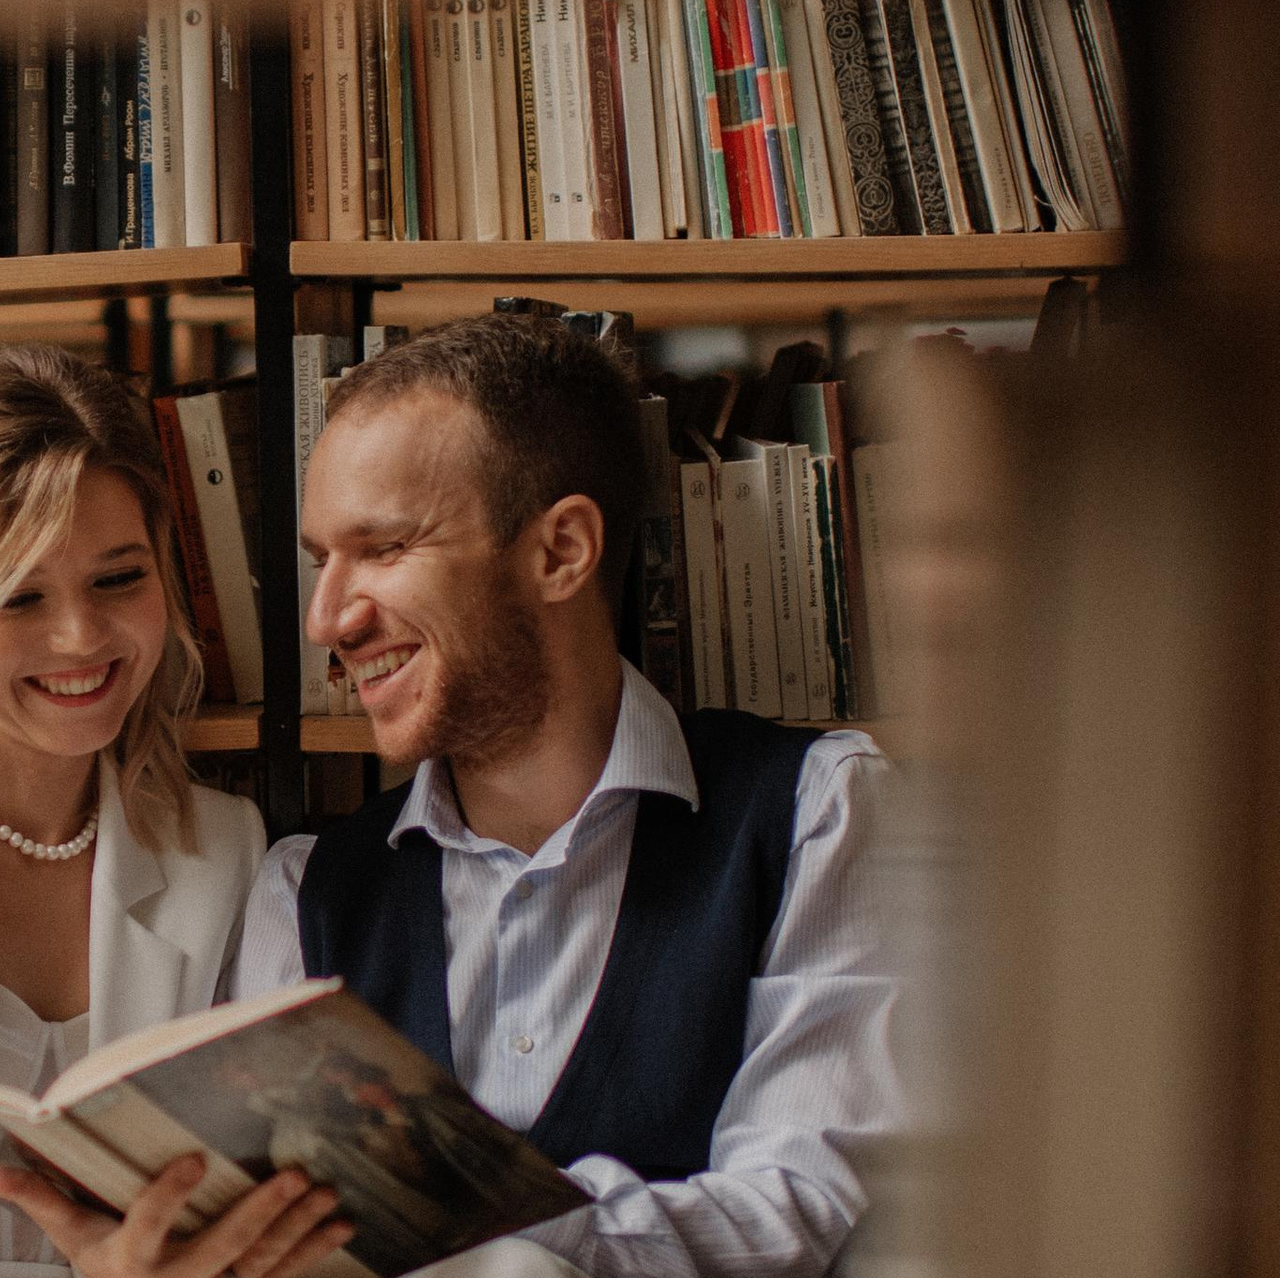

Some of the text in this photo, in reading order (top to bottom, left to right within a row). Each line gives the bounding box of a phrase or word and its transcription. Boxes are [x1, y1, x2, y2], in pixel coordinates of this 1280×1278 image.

[627, 4, 639, 63] МИХАИЛ
[63, 48, 78, 125] Пересечение
[523, 68, 535, 114] ПЕТРА
[541, 43, 552, 96] БАРТЕНЕВА
[302, 72, 314, 131] Художник
[337, 72, 349, 131] Художник
[62, 130, 76, 185] В.Фомин
[125, 100, 136, 243] И.Гращенкова Абрам Роом
[163, 136, 172, 172] МИХАИЛ
[339, 134, 350, 190] каменных
[525, 117, 538, 172] ЖИТИЕ
[306, 193, 316, 213] дел
[341, 193, 351, 213] дел
[299, 350, 310, 428] ЖИВОПИСЬ
[311, 380, 319, 398] XIX
[776, 499, 788, 550] ЖИВОПИСЬ
[806, 518, 817, 565] Нидерландов
[780, 555, 792, 620] ФЛАМАНДСКАЯ
[808, 569, 819, 608] Искусство
[743, 562, 759, 703] Государственный Эрмитаж
